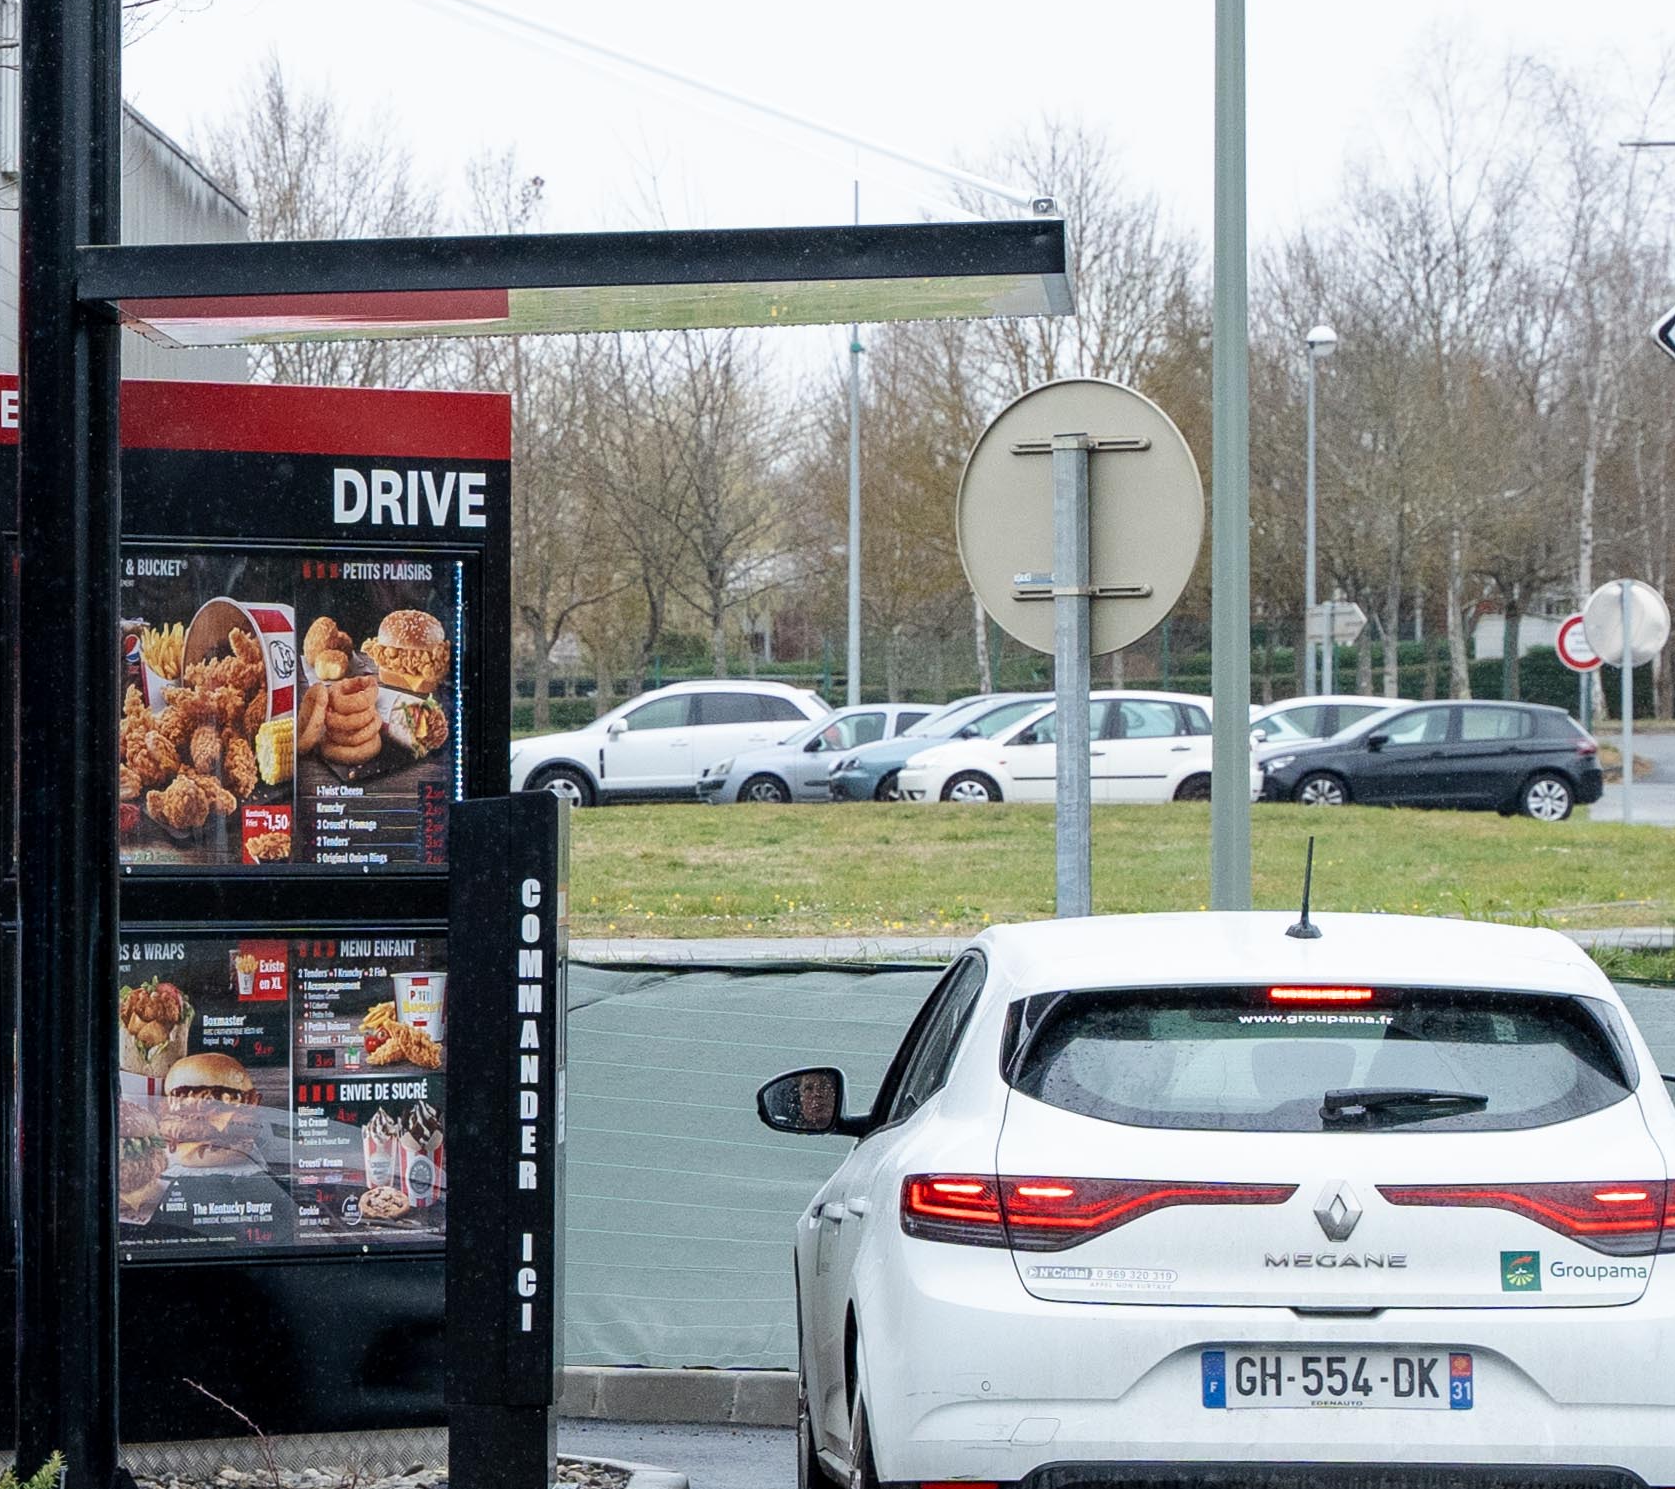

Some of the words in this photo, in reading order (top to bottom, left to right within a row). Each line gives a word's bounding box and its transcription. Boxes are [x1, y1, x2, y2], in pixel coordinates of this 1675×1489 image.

[333, 467, 487, 527] DRIVE
[343, 563, 379, 580] PETITS
[382, 563, 433, 581] PLAISIRS
[132, 945, 141, 960] &
[144, 943, 185, 960] WRAPS
[340, 940, 371, 957] MENU
[374, 939, 416, 957] ENFANT
[259, 959, 286, 973] Existe
[1238, 1014, 1394, 1024] www.groupama.fr
[517, 878, 543, 1190] COMMANDER
[340, 1084, 372, 1101] ENVIE
[375, 1083, 390, 1100] DE
[392, 1078, 428, 1099] SUCRÉ
[193, 1203, 208, 1215] The
[209, 1201, 244, 1215] Kentucky
[246, 1201, 272, 1215] Burger
[1264, 1252, 1407, 1269] MEGANE
[1096, 1270, 1102, 1278] 0
[1107, 1270, 1126, 1279] 969
[1130, 1270, 1149, 1280] 320
[1550, 1261, 1647, 1281] Groupama
[517, 1233, 537, 1332] ICI
[1210, 1381, 1218, 1393] F
[1235, 1356, 1439, 1398] GH-554-DK
[1452, 1381, 1472, 1400] 31
